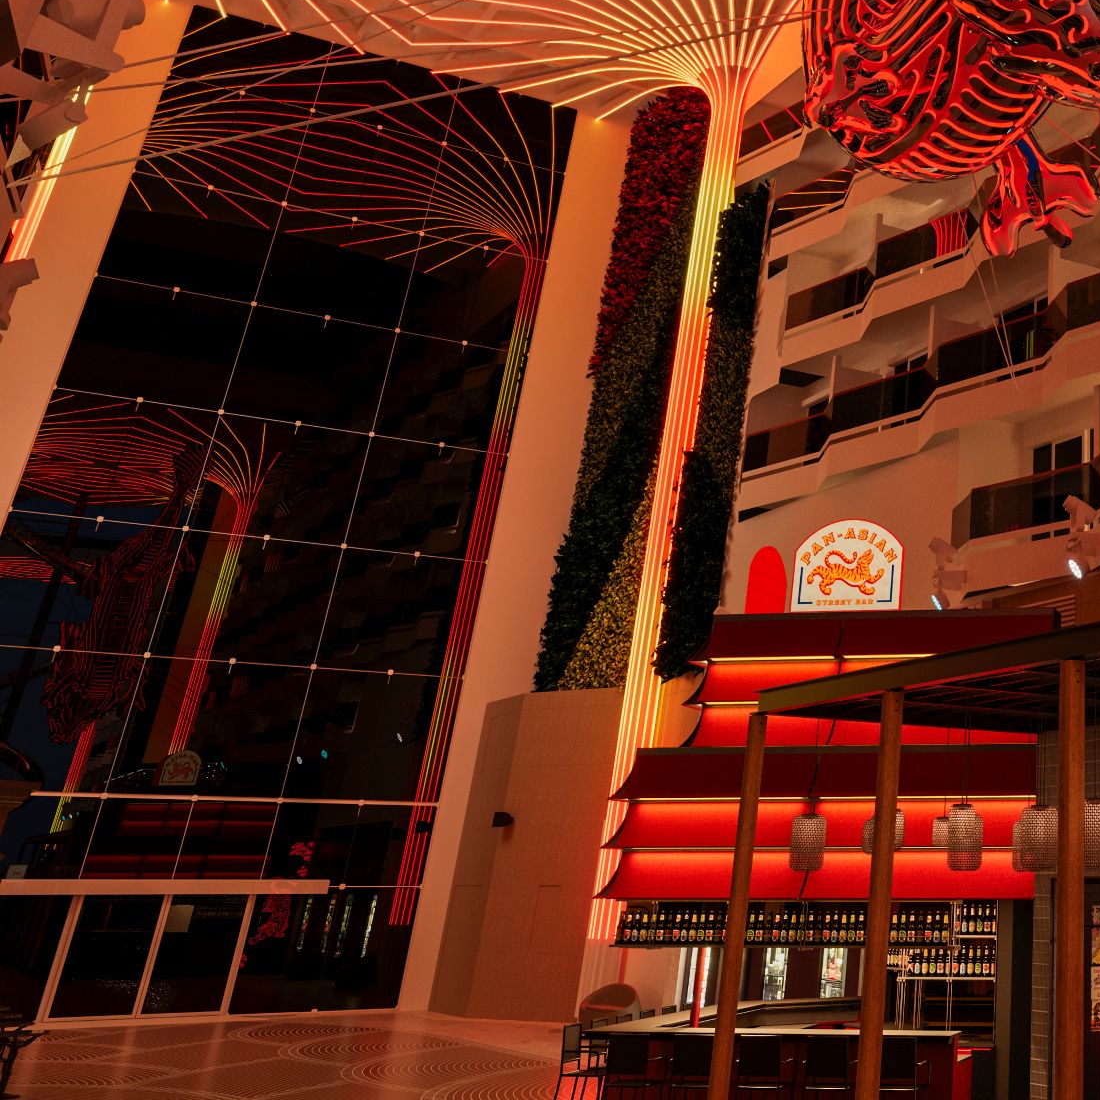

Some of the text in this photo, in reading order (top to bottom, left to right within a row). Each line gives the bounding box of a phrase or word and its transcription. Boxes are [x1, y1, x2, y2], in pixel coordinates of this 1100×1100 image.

[800, 528, 898, 566] PAN-ASIAN
[816, 598, 874, 607] STREET BAR
